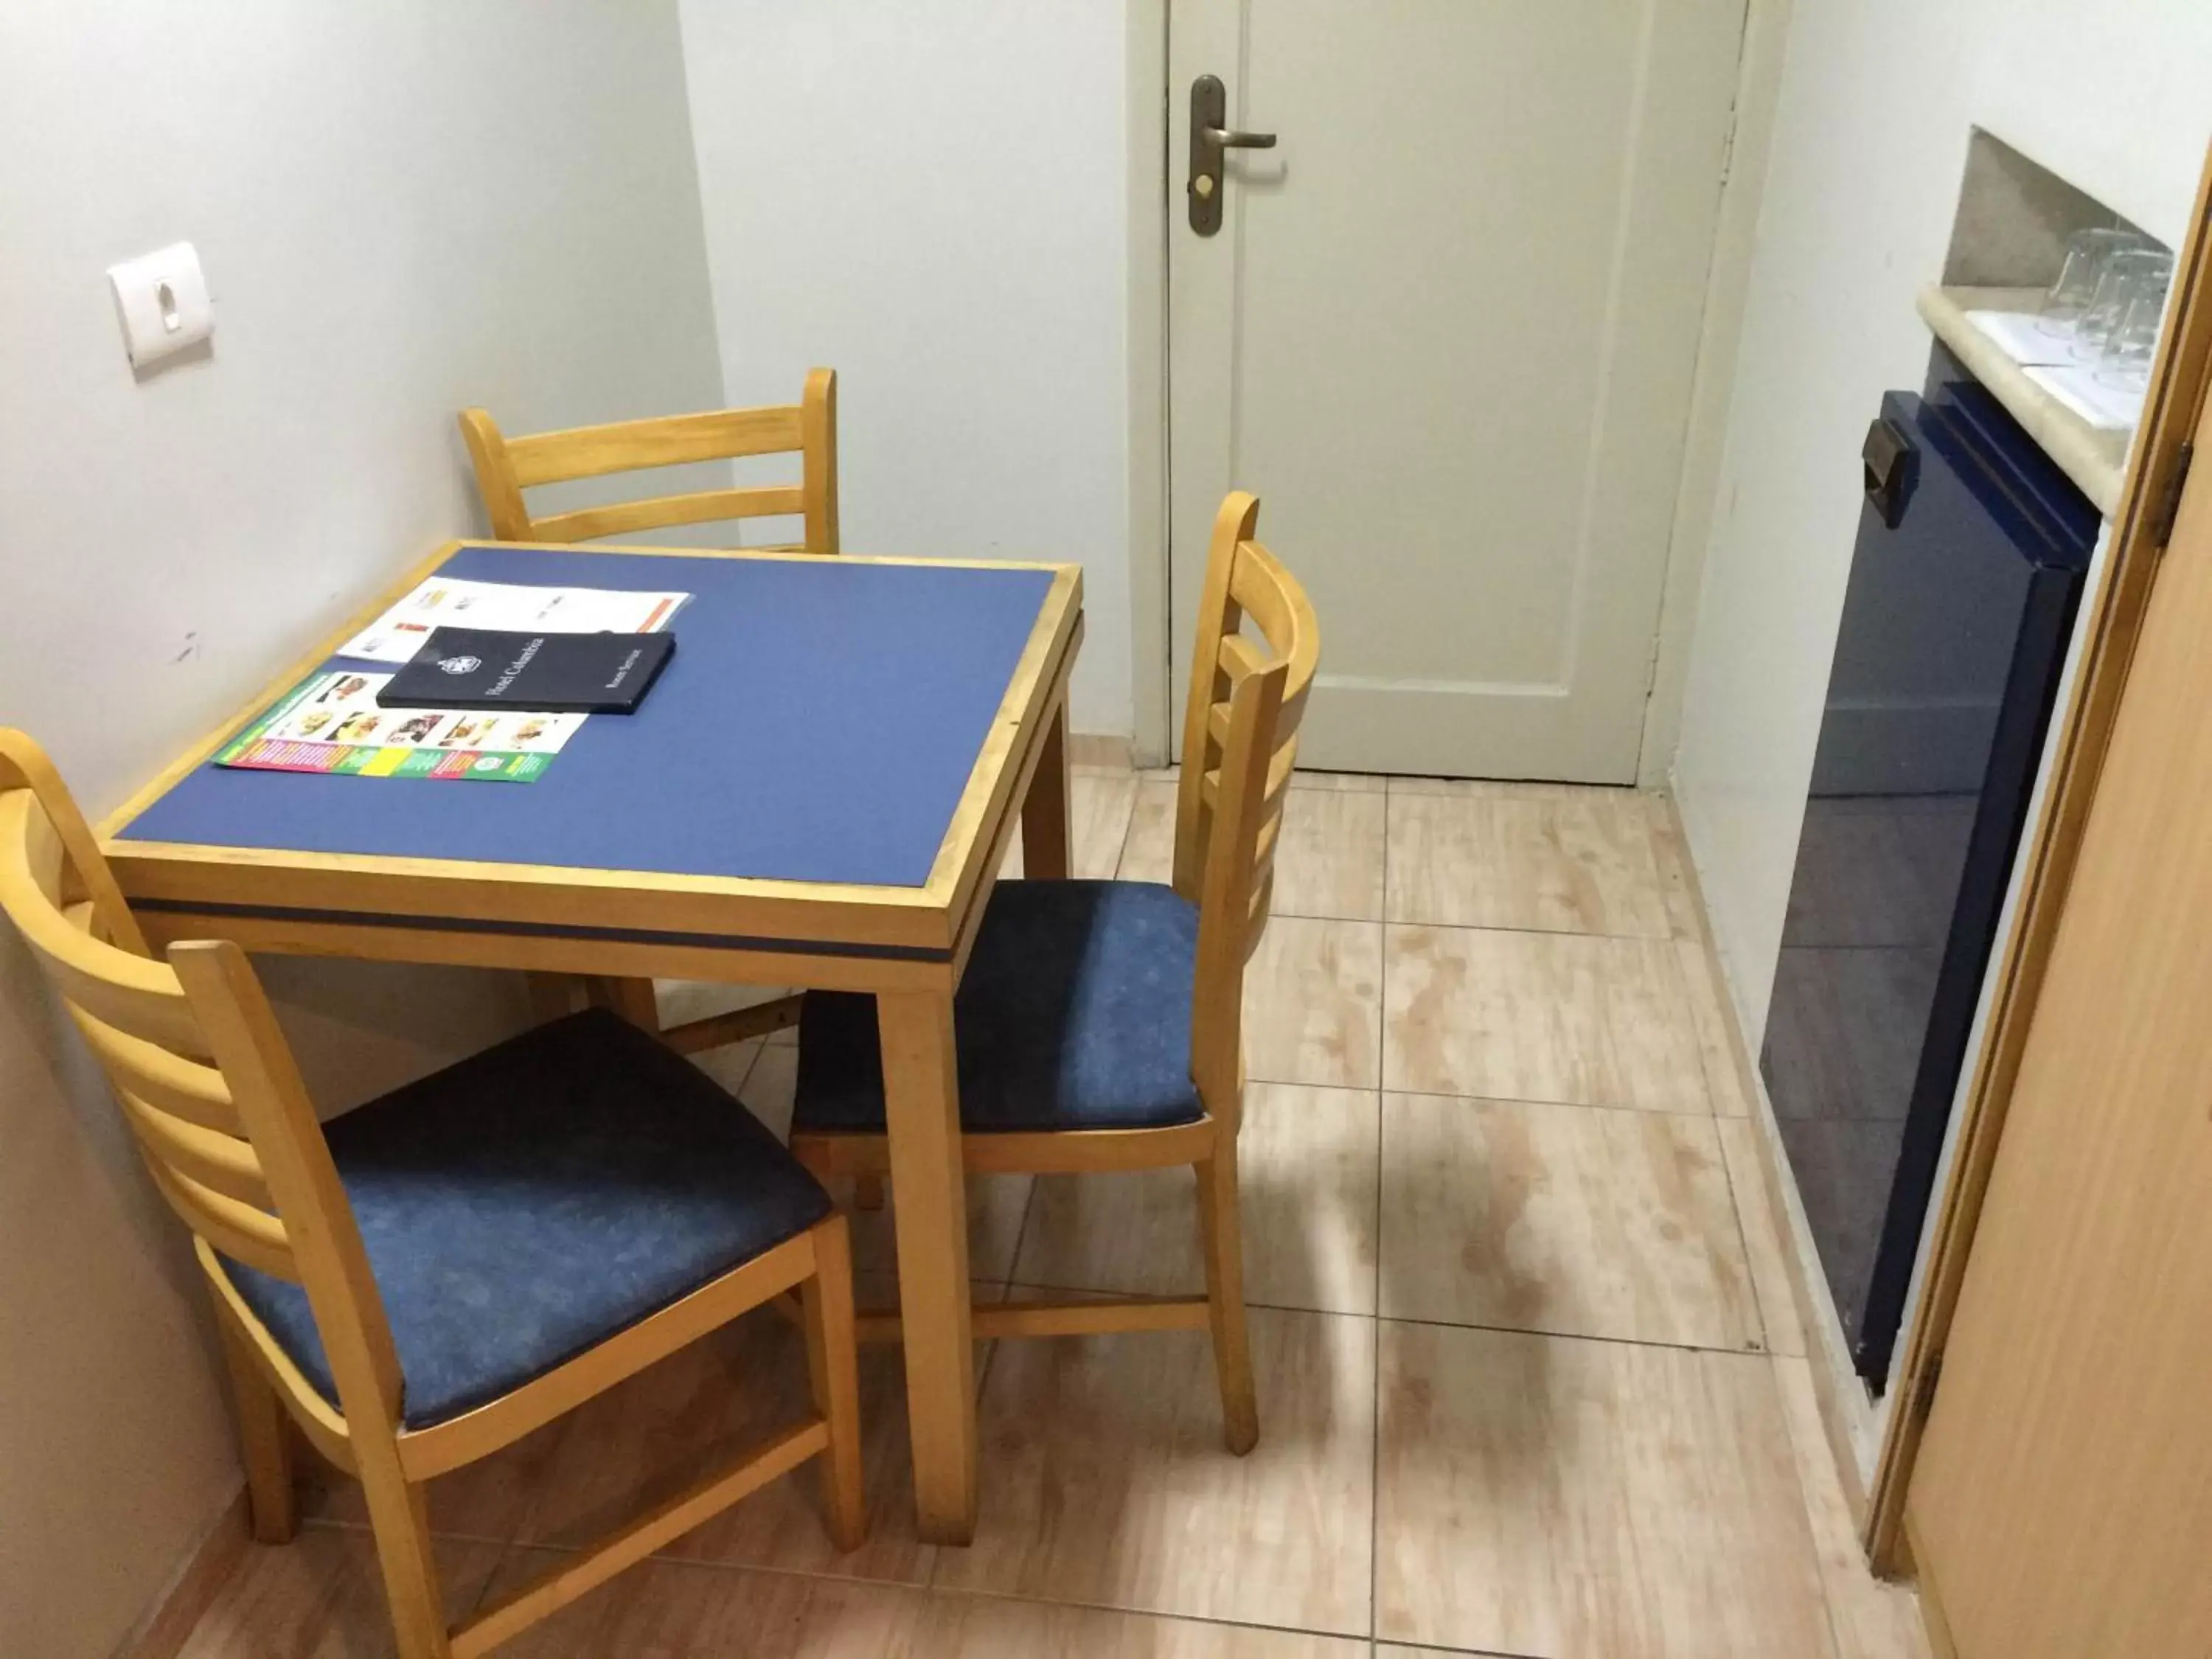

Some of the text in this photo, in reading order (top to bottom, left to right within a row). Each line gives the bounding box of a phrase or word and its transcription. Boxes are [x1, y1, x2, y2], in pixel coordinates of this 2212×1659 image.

[605, 648, 642, 688] Room Service
[485, 675, 515, 695] Hotel
